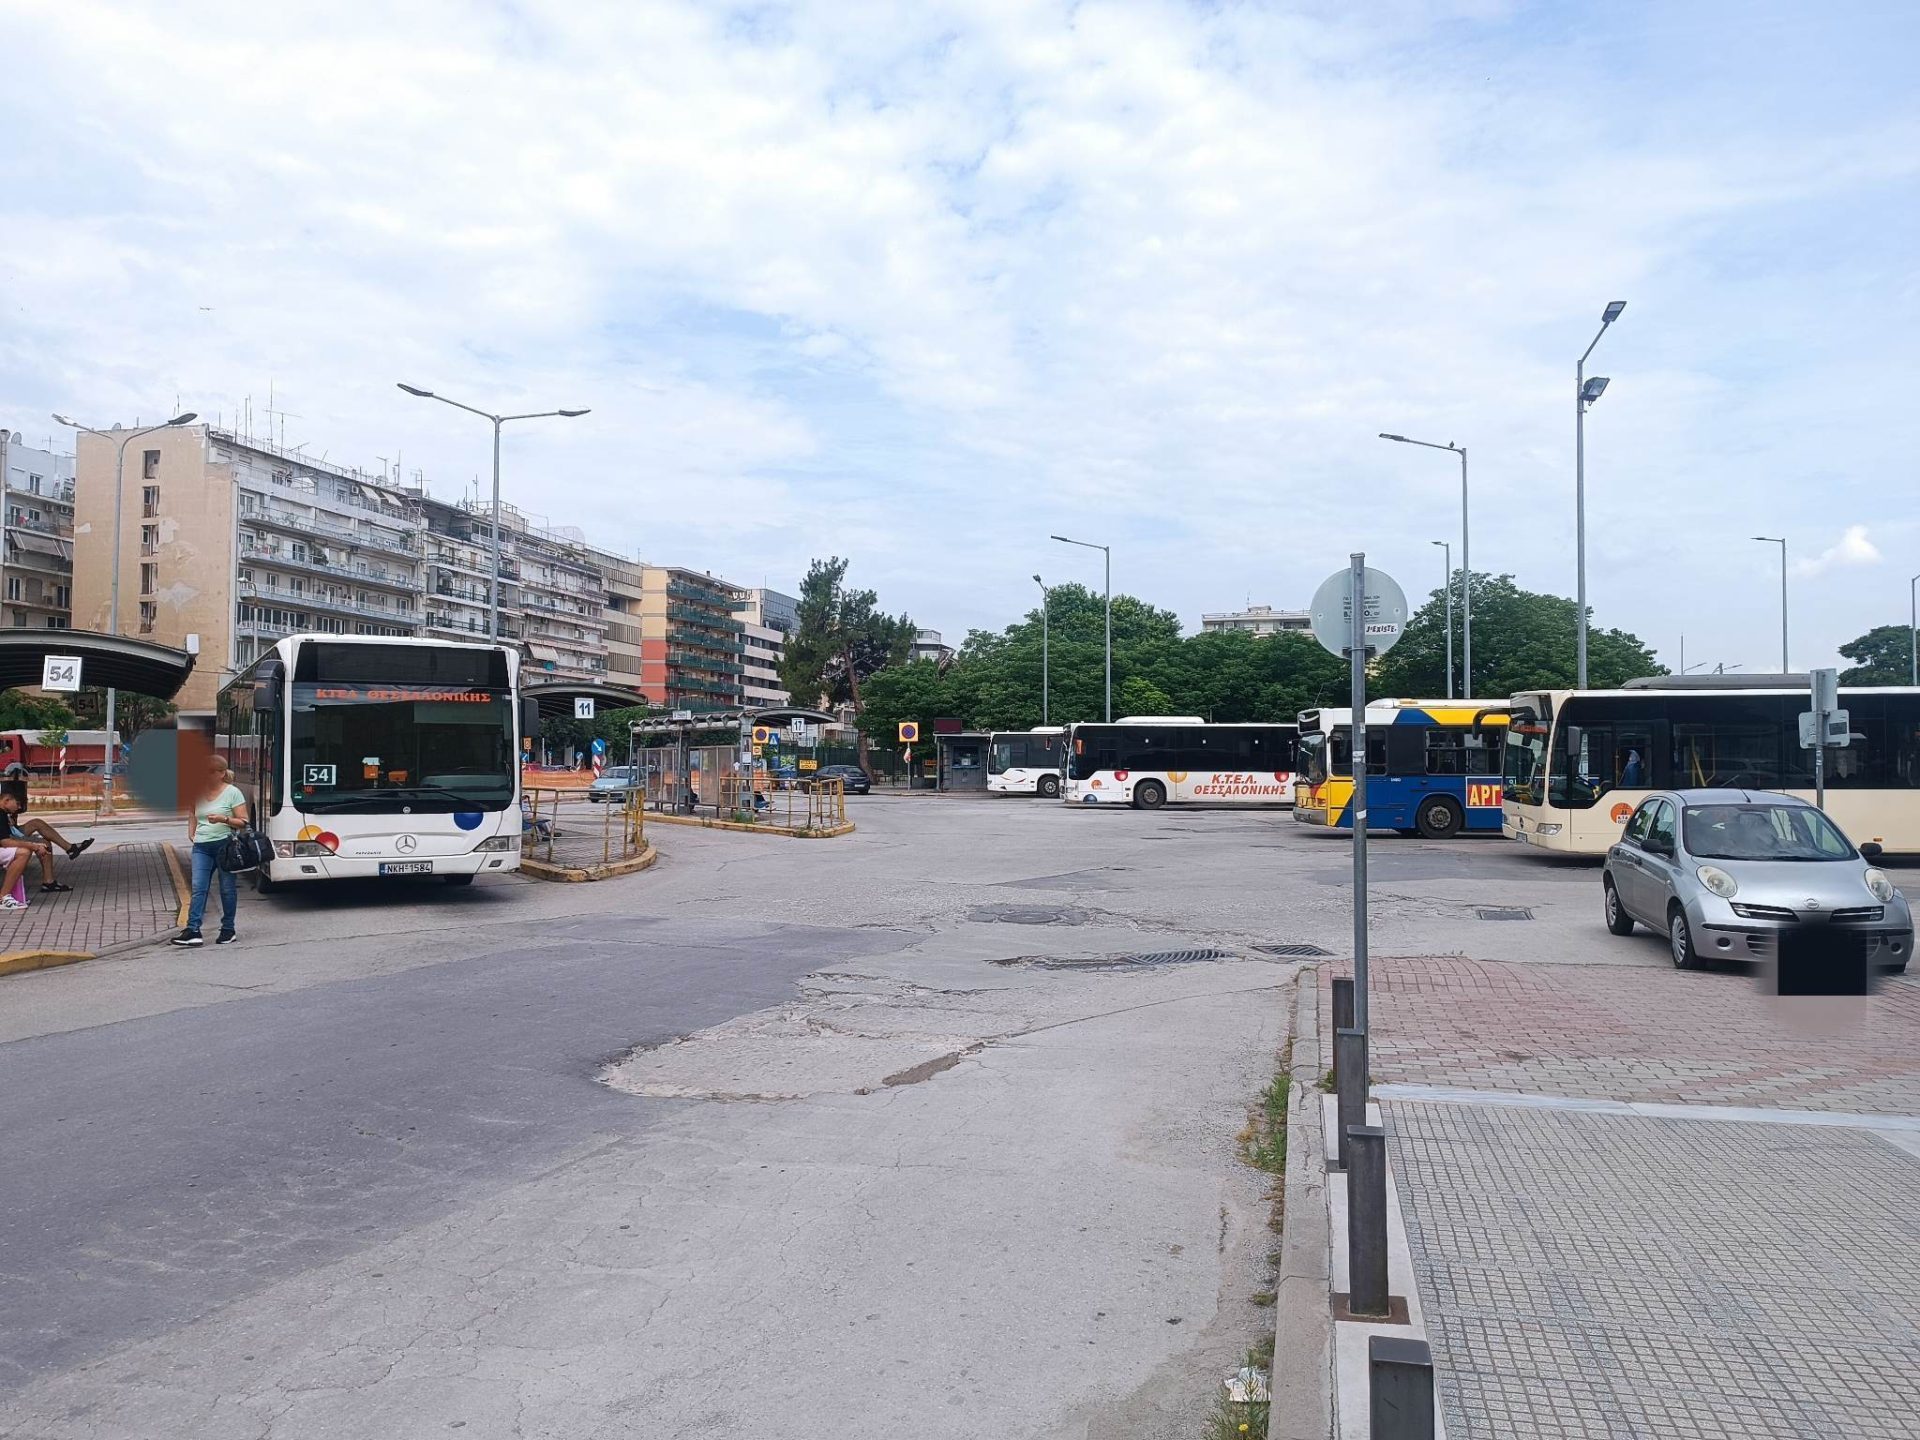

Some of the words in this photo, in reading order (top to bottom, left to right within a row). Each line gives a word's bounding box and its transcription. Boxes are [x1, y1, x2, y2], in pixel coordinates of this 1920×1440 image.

[49, 666, 74, 682] 54
[579, 702, 591, 716] 11
[794, 720, 802, 731] 17
[308, 768, 329, 782] 54
[1211, 774, 1257, 784] Κ.Τ.Ε.Λ.
[1194, 785, 1287, 797] ΘΕΣΣΑΛΟΝΙΚΗΣ
